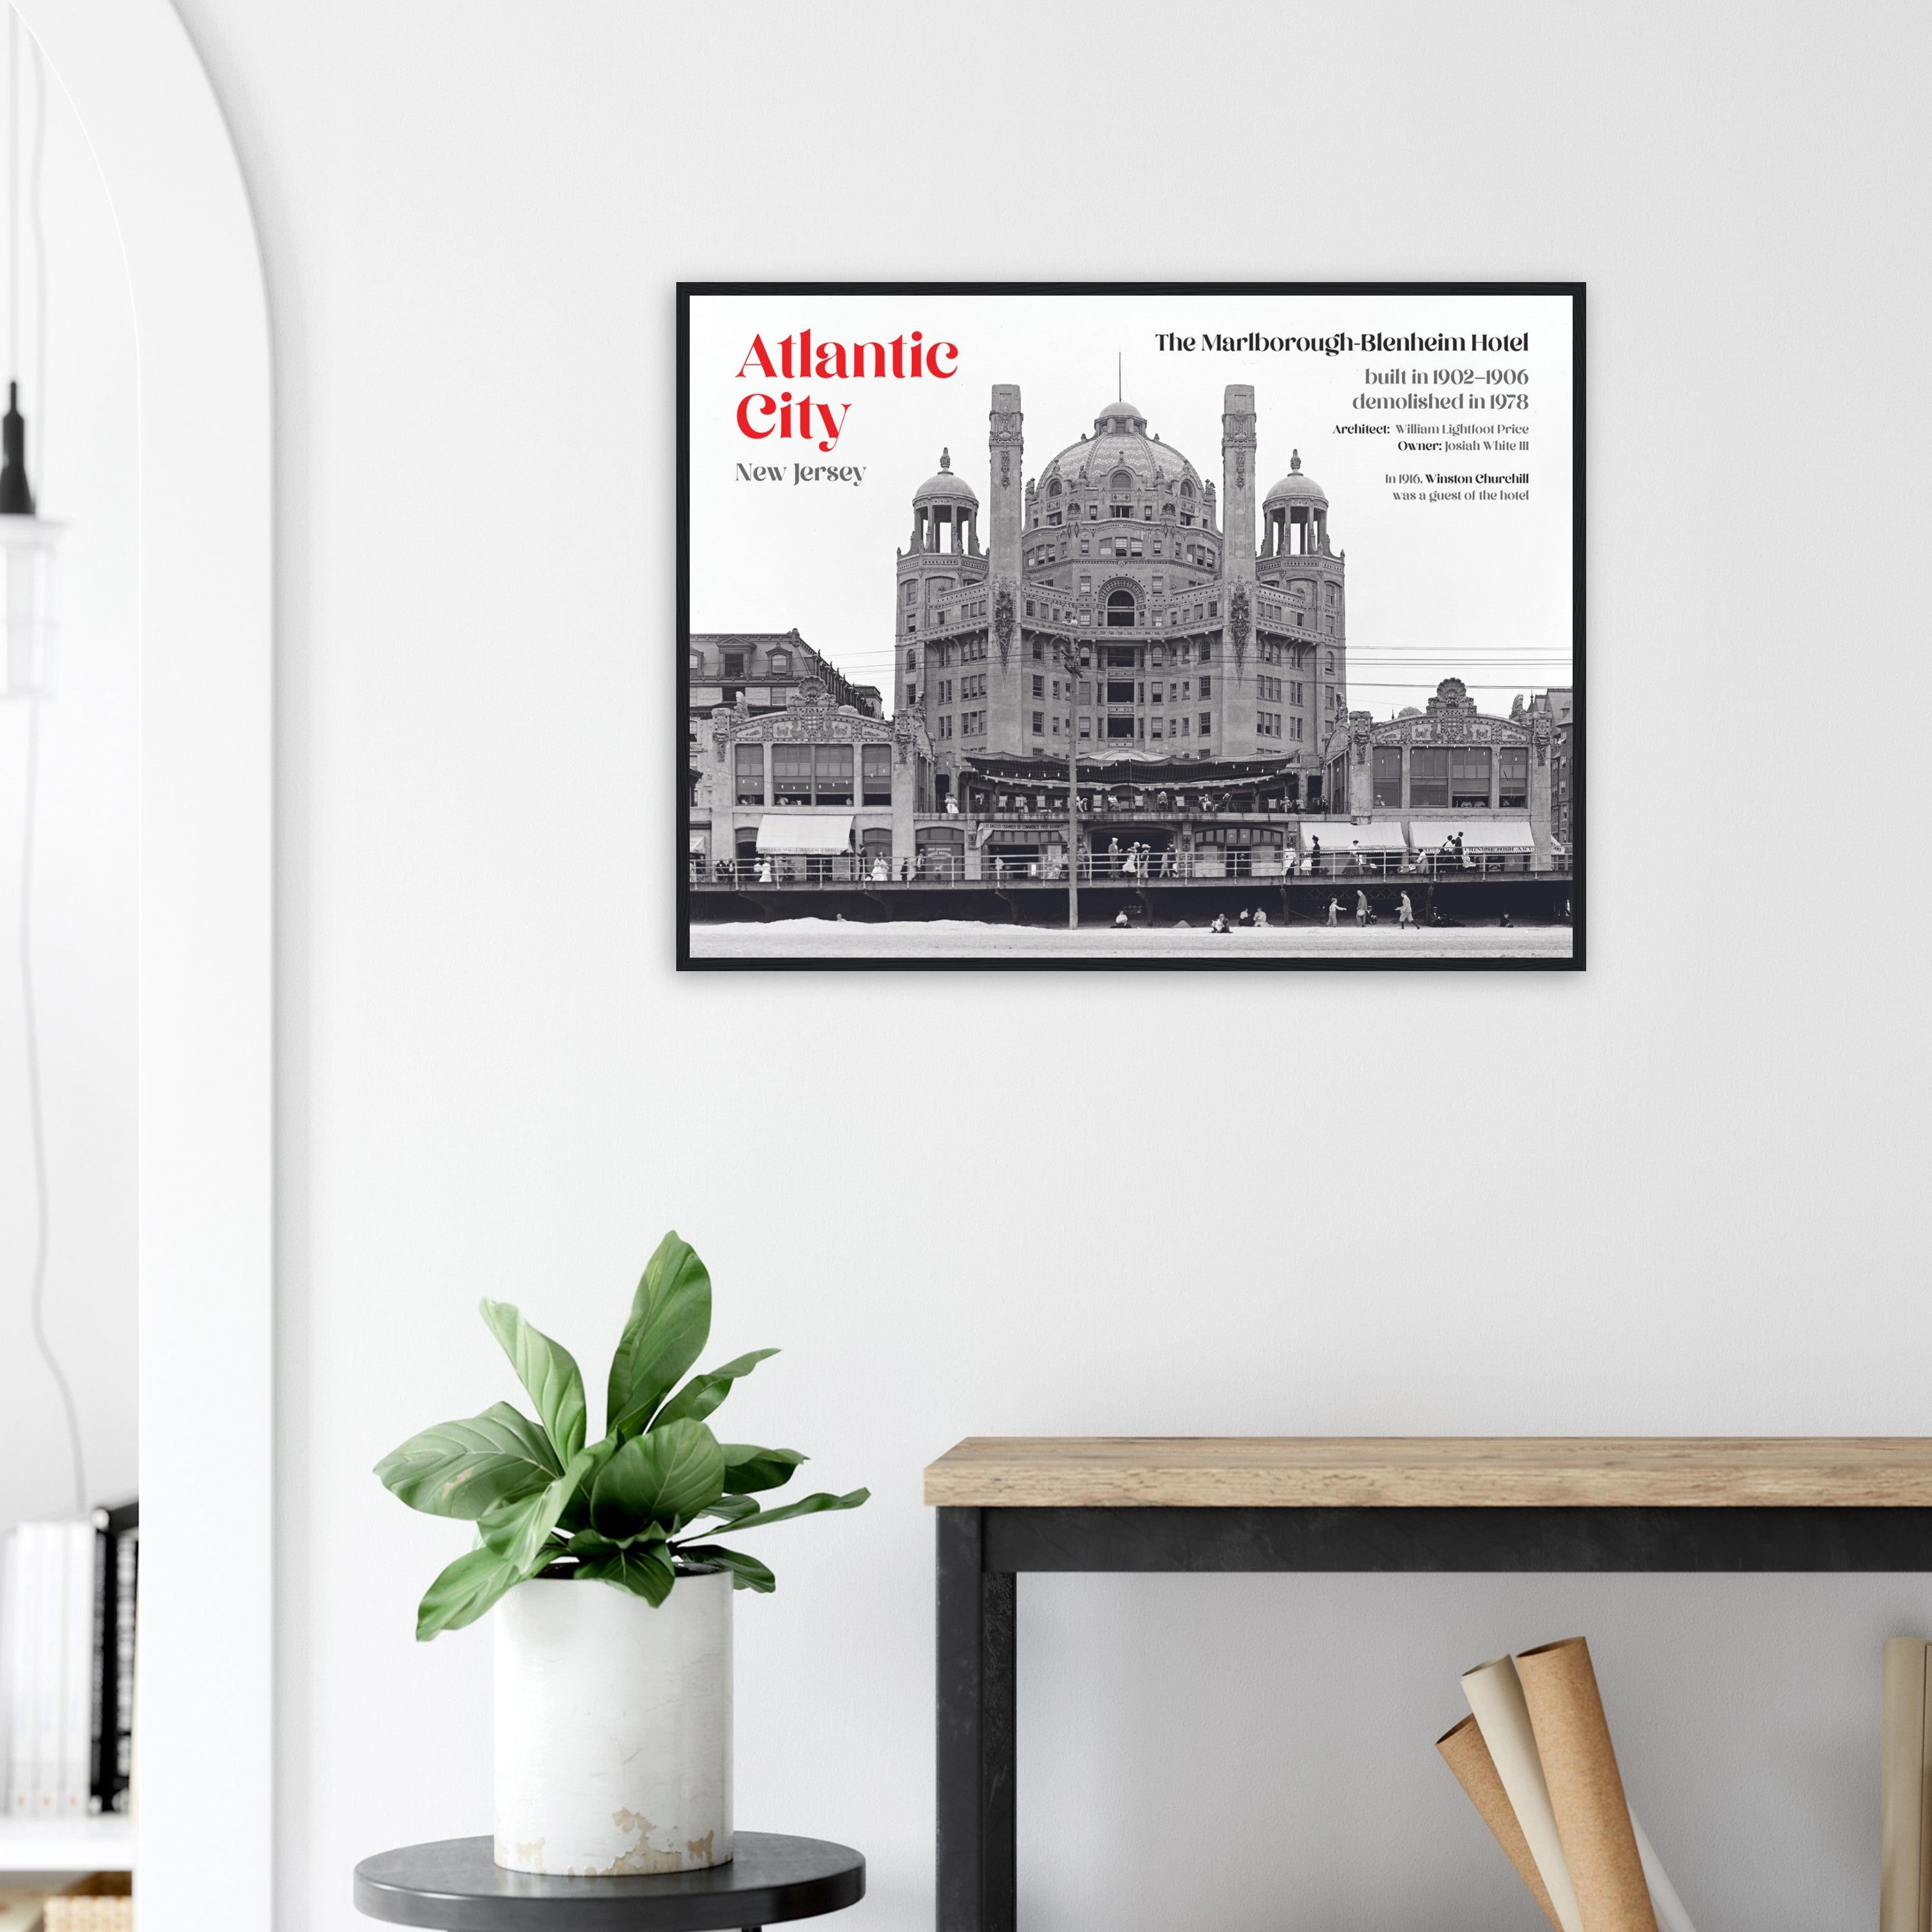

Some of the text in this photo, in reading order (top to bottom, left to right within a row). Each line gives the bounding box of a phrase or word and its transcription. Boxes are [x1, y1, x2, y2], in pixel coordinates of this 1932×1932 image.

[1155, 332, 1529, 357] The Marlborough-Blenheim Hotel
[735, 328, 959, 379] Atlantic
[1365, 368, 1529, 385] built in 1902–1906
[1352, 393, 1529, 410] demolished in 1978
[736, 392, 853, 453] City
[1332, 424, 1529, 437] Architect: William Lightfoot Price
[1397, 440, 1529, 453] Owner: Josiah White III
[736, 463, 867, 487] New Jersey
[1385, 474, 1396, 484] In
[1425, 474, 1472, 484] Winston
[1475, 473, 1529, 484] Churchill
[1428, 491, 1461, 503] guest
[1464, 490, 1475, 500] of
[1479, 490, 1497, 500] the
[1500, 490, 1529, 500] hotel
